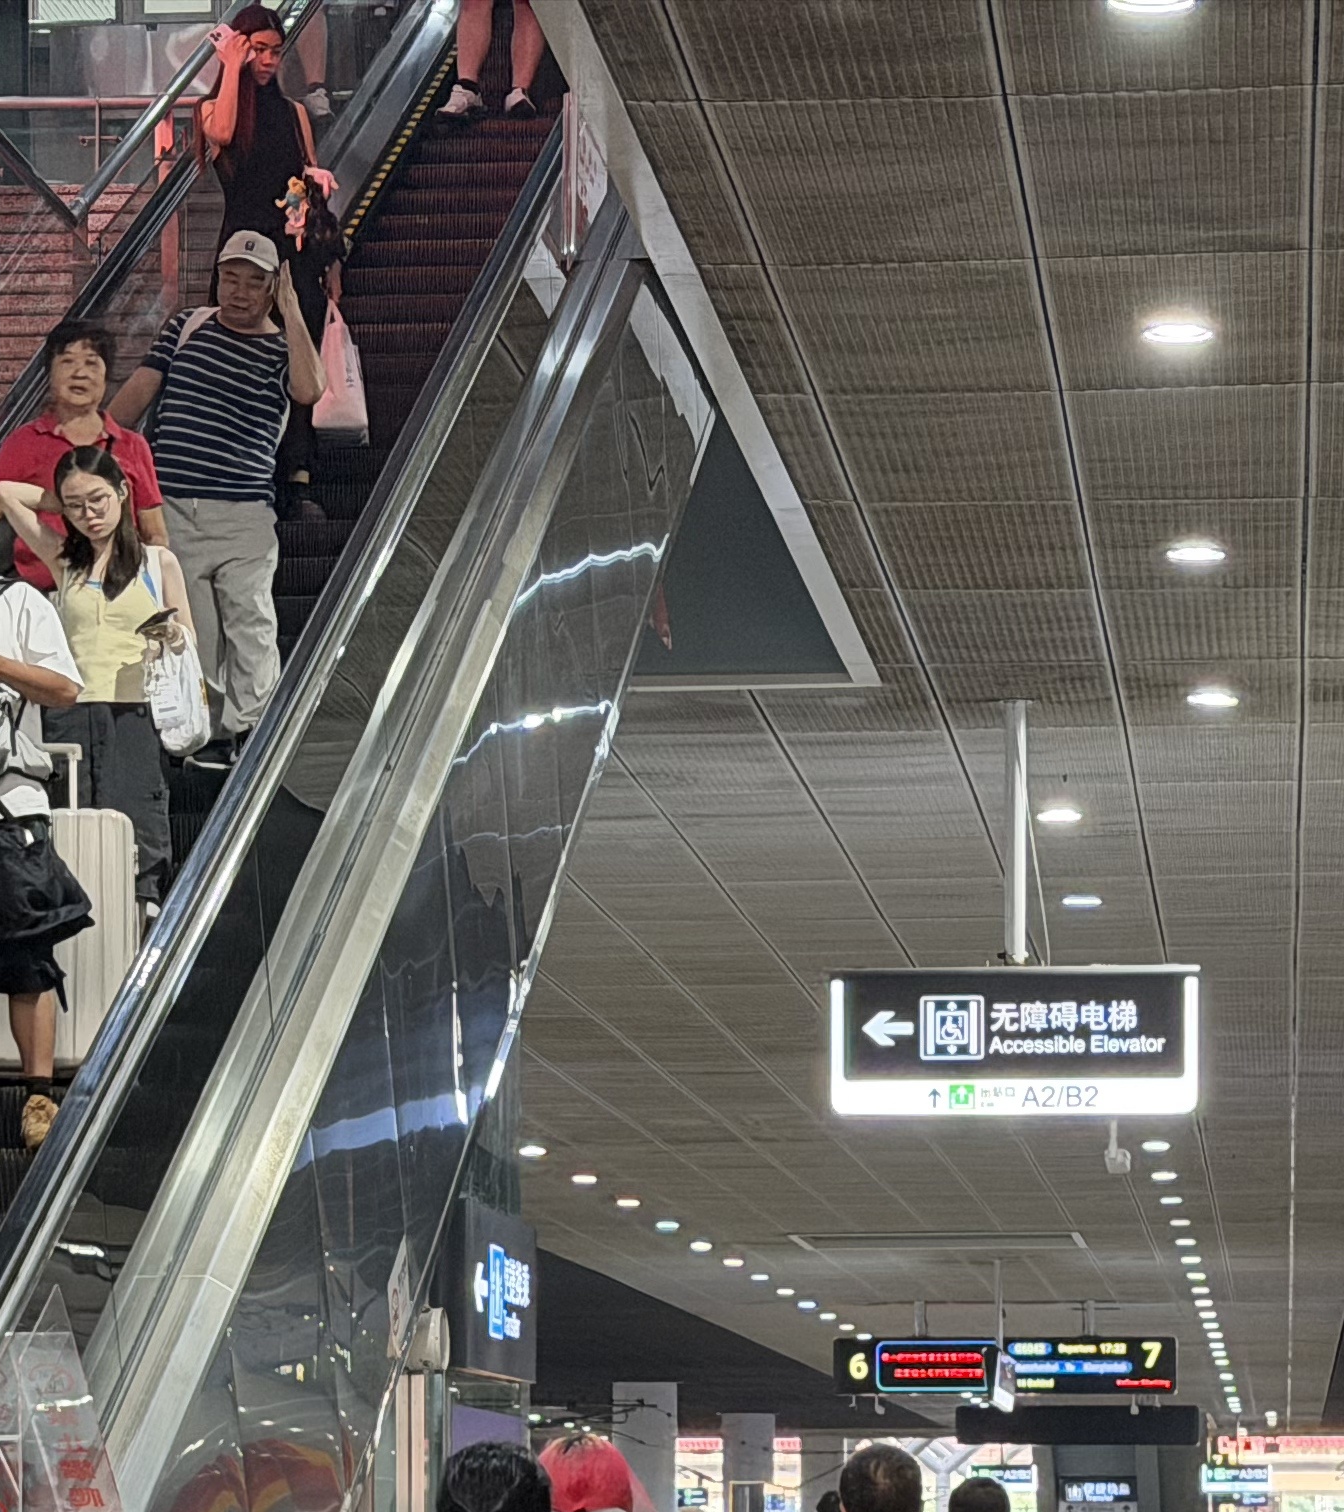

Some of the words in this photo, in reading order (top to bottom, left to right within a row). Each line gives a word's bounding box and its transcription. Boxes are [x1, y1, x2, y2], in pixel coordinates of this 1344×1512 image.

[989, 999, 1139, 1033] 无障碍电梯
[988, 1035, 1086, 1055] Accessible
[1090, 1034, 1167, 1053] Elevator
[1021, 1085, 1099, 1108] A2/B2
[849, 1353, 869, 1380] 6
[1141, 1341, 1162, 1369] 7
